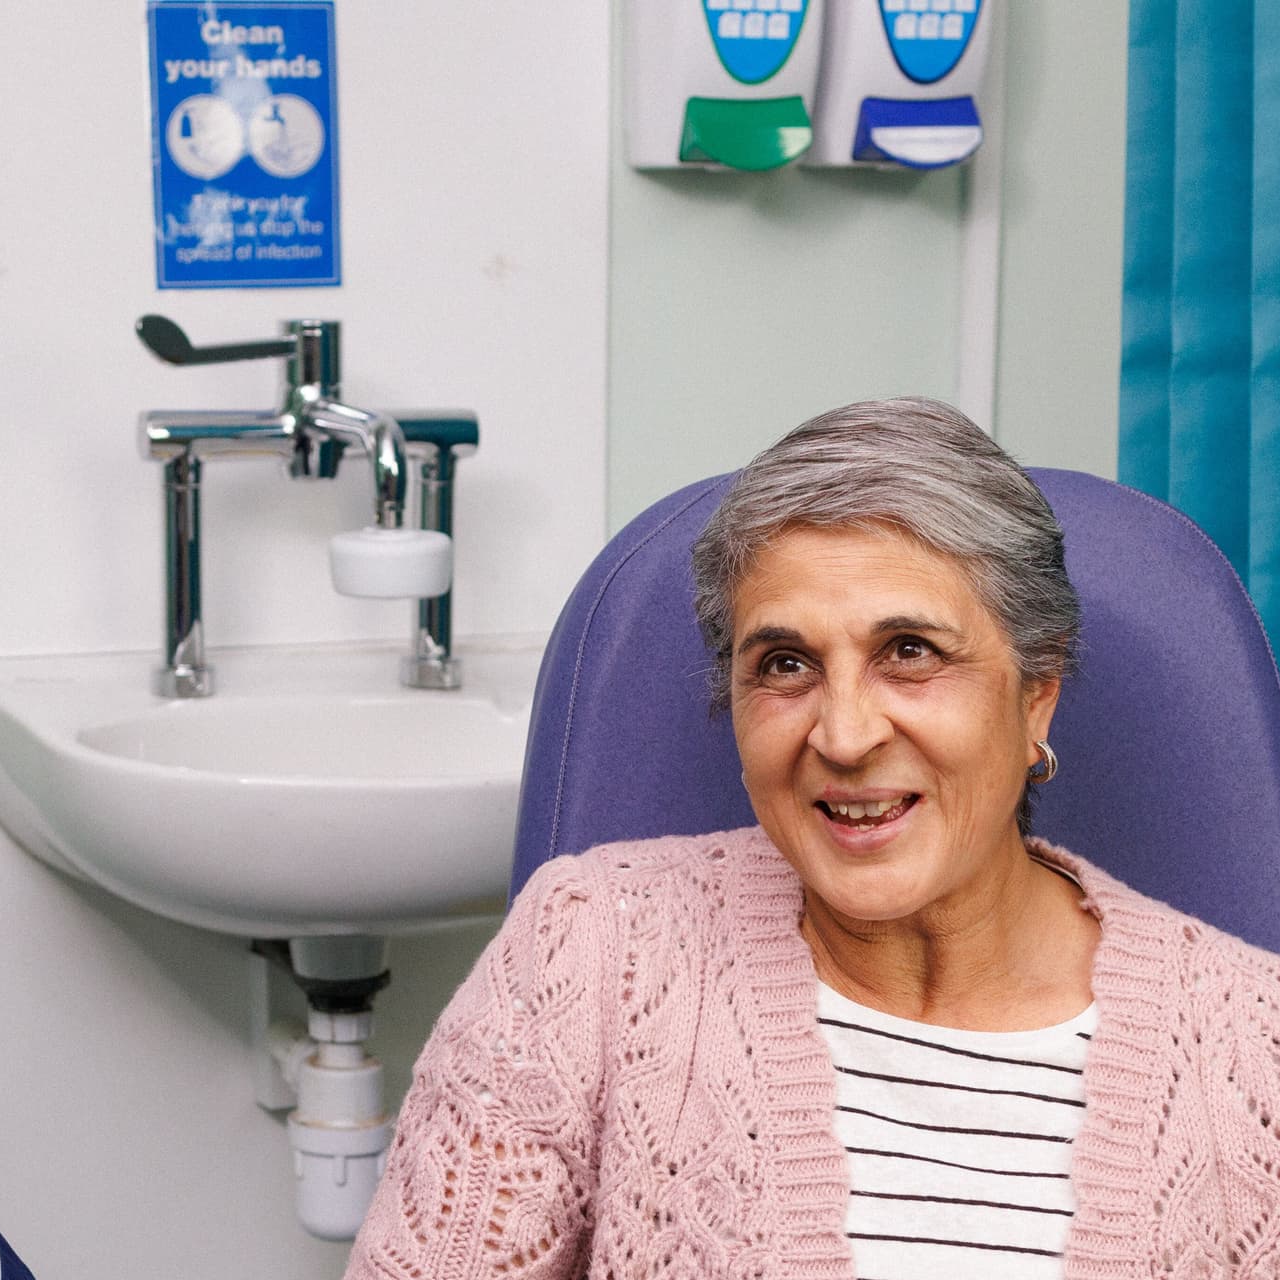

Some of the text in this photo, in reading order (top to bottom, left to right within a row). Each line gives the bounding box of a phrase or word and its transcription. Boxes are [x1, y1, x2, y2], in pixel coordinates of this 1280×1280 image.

[200, 20, 284, 45] Clean
[165, 55, 322, 83] your hands
